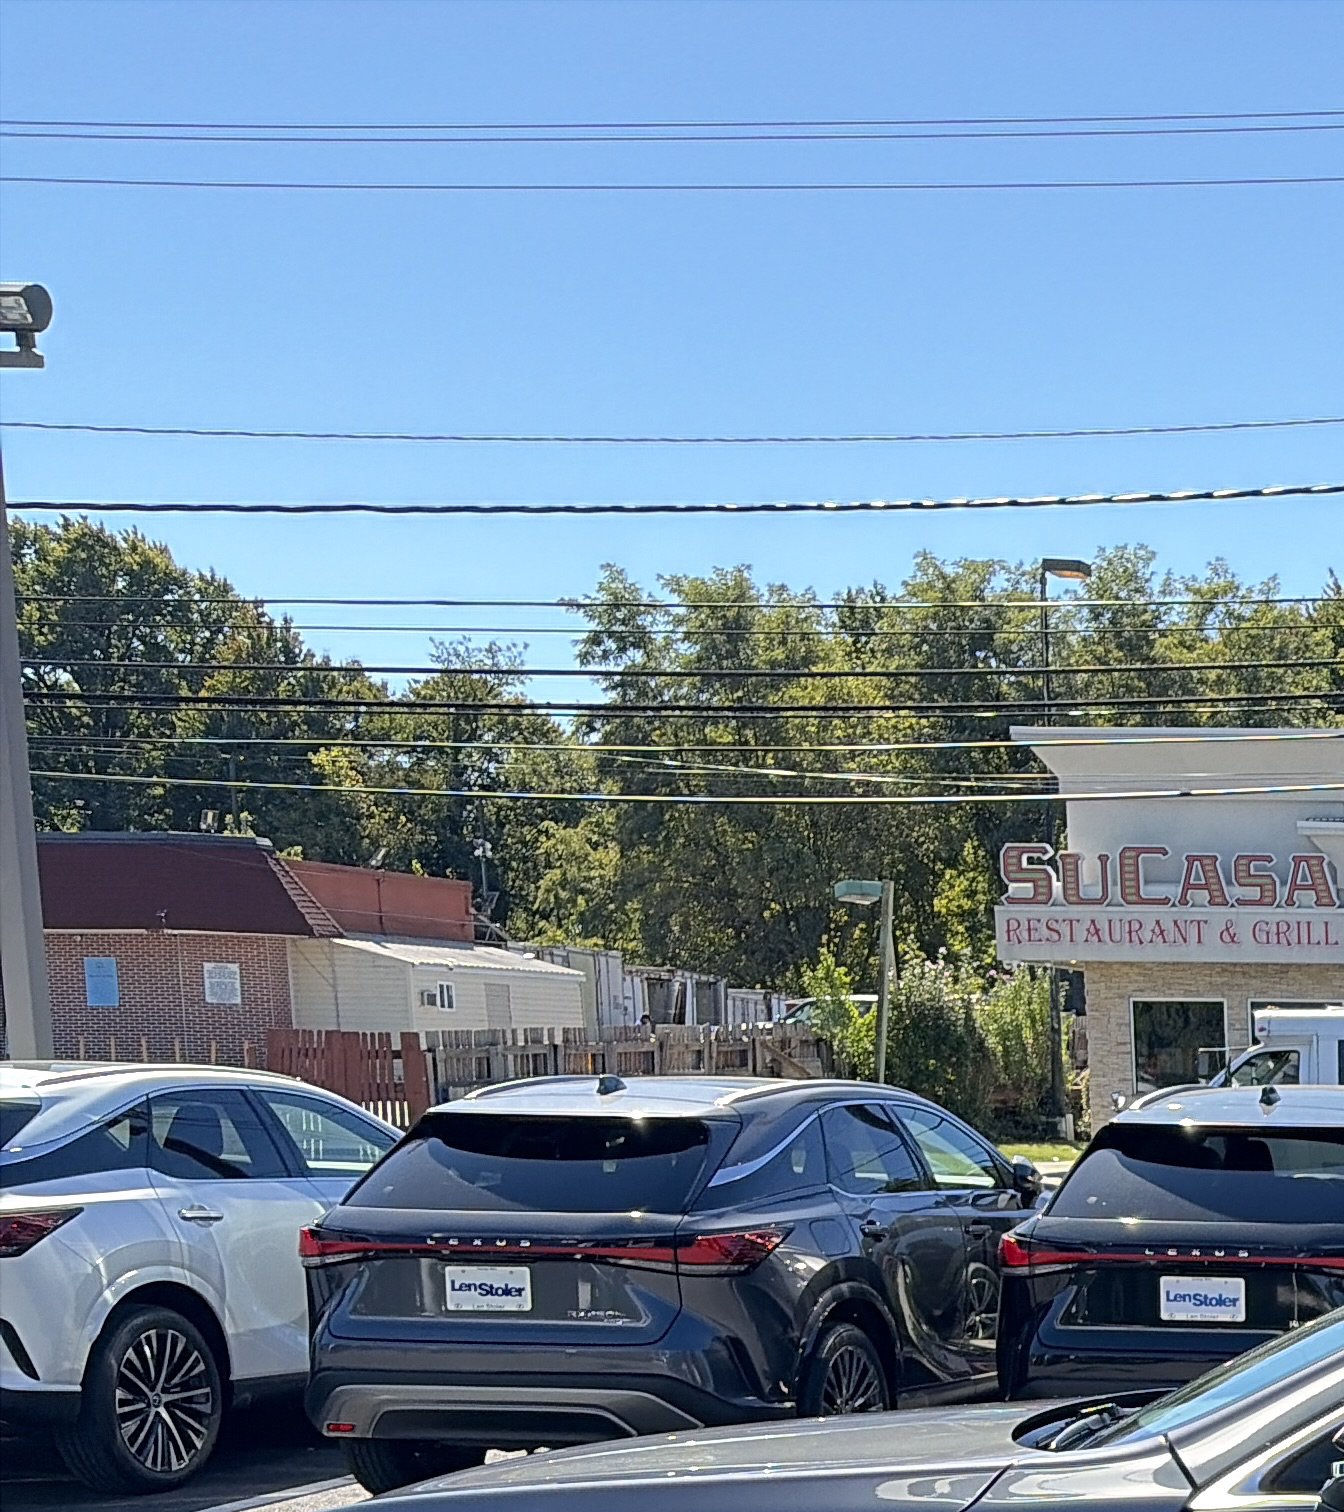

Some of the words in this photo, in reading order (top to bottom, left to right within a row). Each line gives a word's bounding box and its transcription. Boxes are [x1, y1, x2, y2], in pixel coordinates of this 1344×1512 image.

[1005, 917, 1208, 947] RESTAURANT
[1219, 921, 1241, 945] &
[1251, 918, 1340, 947] GRILL
[427, 1238, 531, 1247] LEXUS
